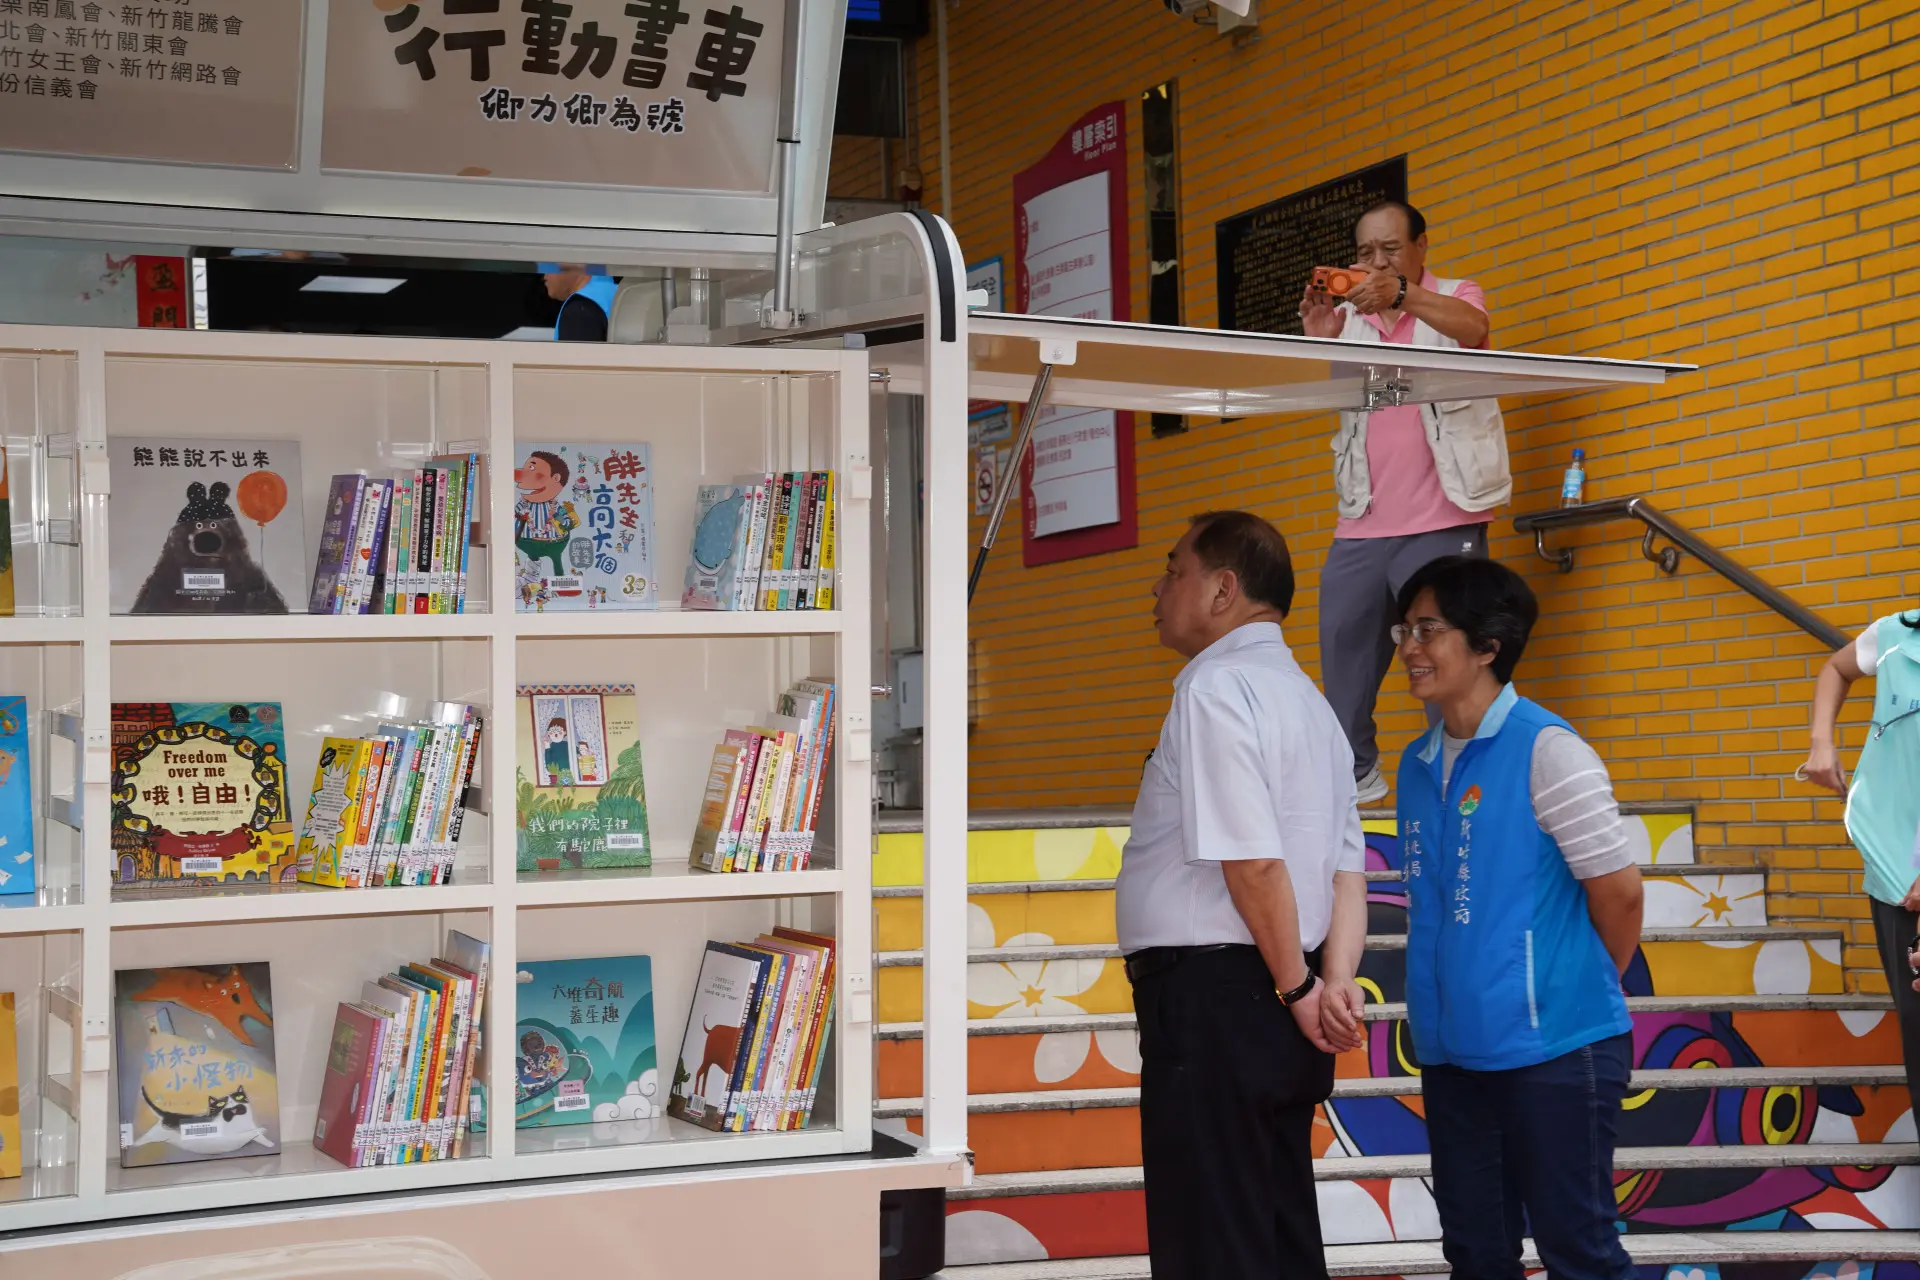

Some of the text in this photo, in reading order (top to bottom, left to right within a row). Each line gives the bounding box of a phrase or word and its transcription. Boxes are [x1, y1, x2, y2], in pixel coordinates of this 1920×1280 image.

[133, 446, 271, 468] 熊熊說不出來
[588, 484, 618, 575] 高大個
[163, 750, 228, 764] Freedom
[168, 766, 226, 778] over me
[529, 814, 629, 834] 我們的院子裡
[552, 976, 625, 1003] 六堆奇航
[165, 1059, 253, 1092] 小怪物
